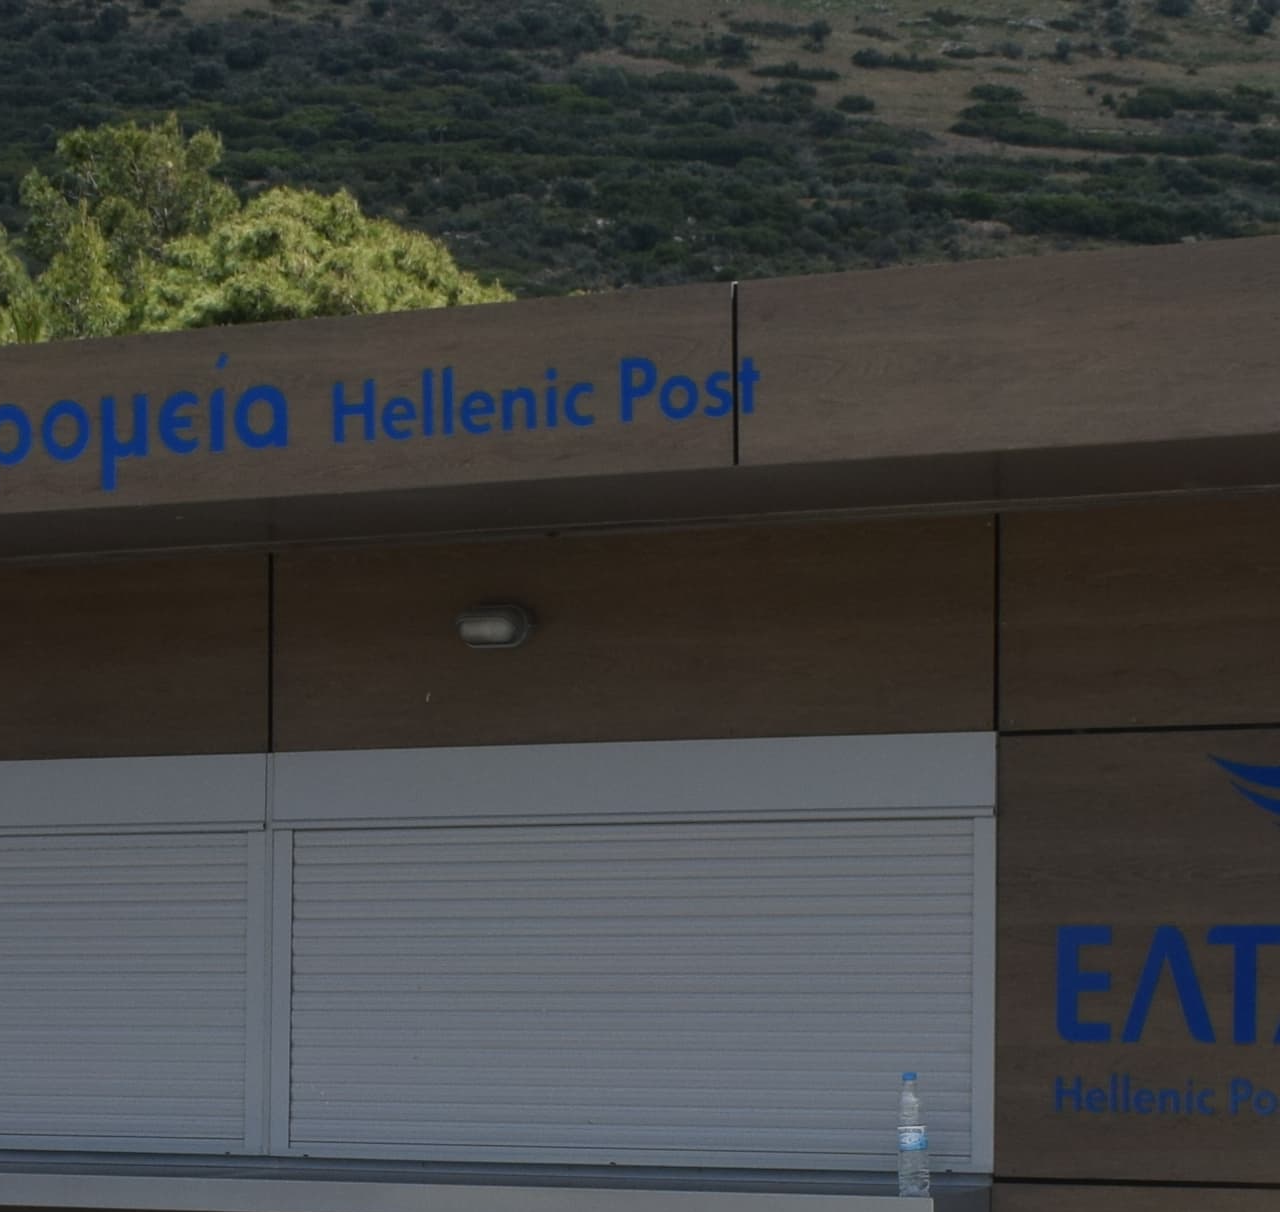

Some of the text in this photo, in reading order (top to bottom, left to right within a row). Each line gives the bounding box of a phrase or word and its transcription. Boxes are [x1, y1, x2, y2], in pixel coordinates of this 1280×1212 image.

[330, 367, 595, 444] Hellenic
[618, 356, 761, 424] Post
[1056, 924, 1280, 1044] ΕΛΤ
[1053, 1073, 1216, 1117] Hellenic
